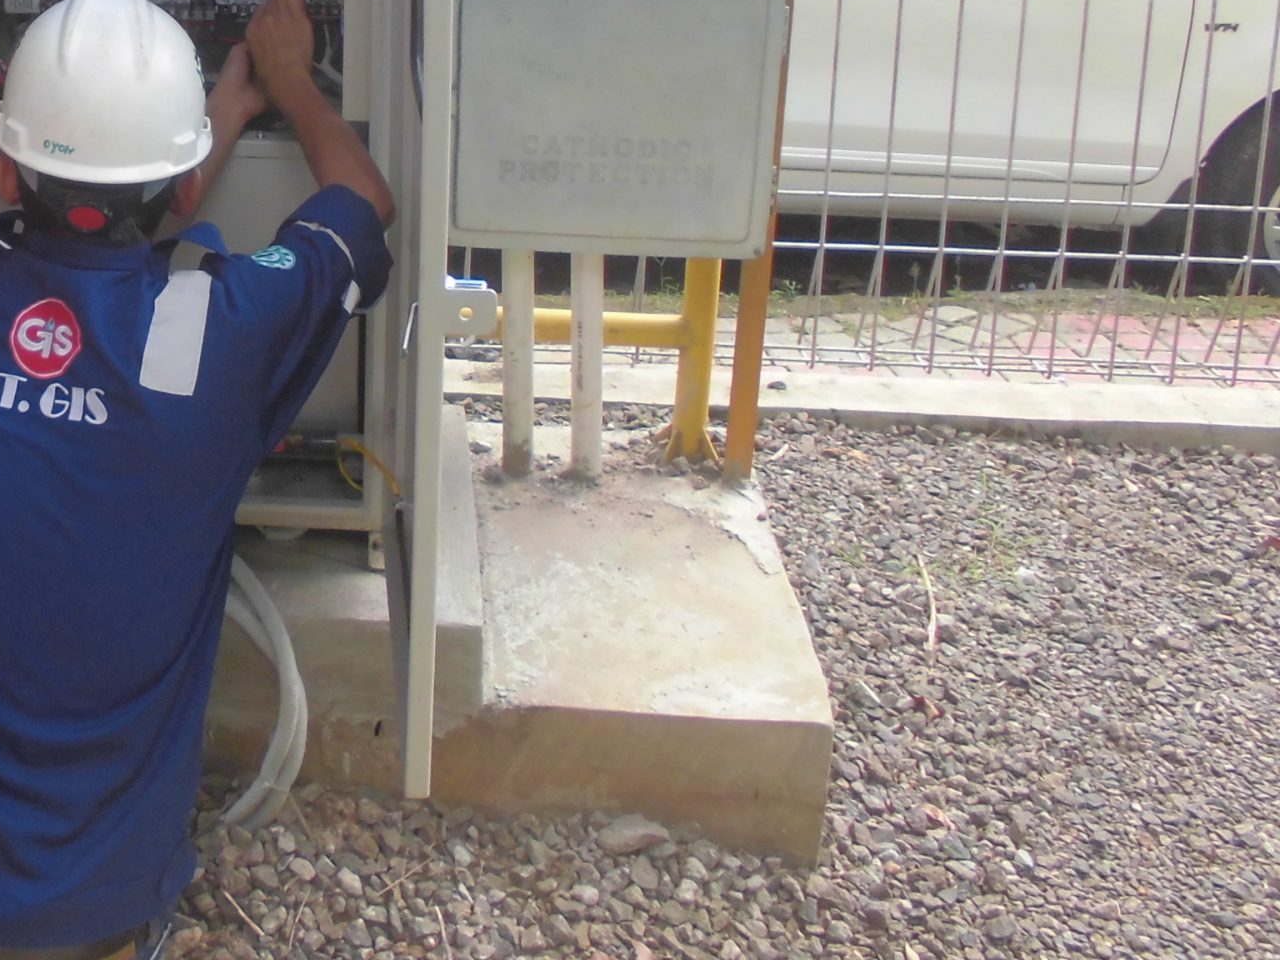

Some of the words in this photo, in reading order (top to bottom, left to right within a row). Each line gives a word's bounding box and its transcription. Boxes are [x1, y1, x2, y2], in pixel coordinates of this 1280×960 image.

[520, 134, 693, 161] CATHODIC
[498, 159, 716, 188] PROTECTION
[39, 382, 108, 425] GIS
